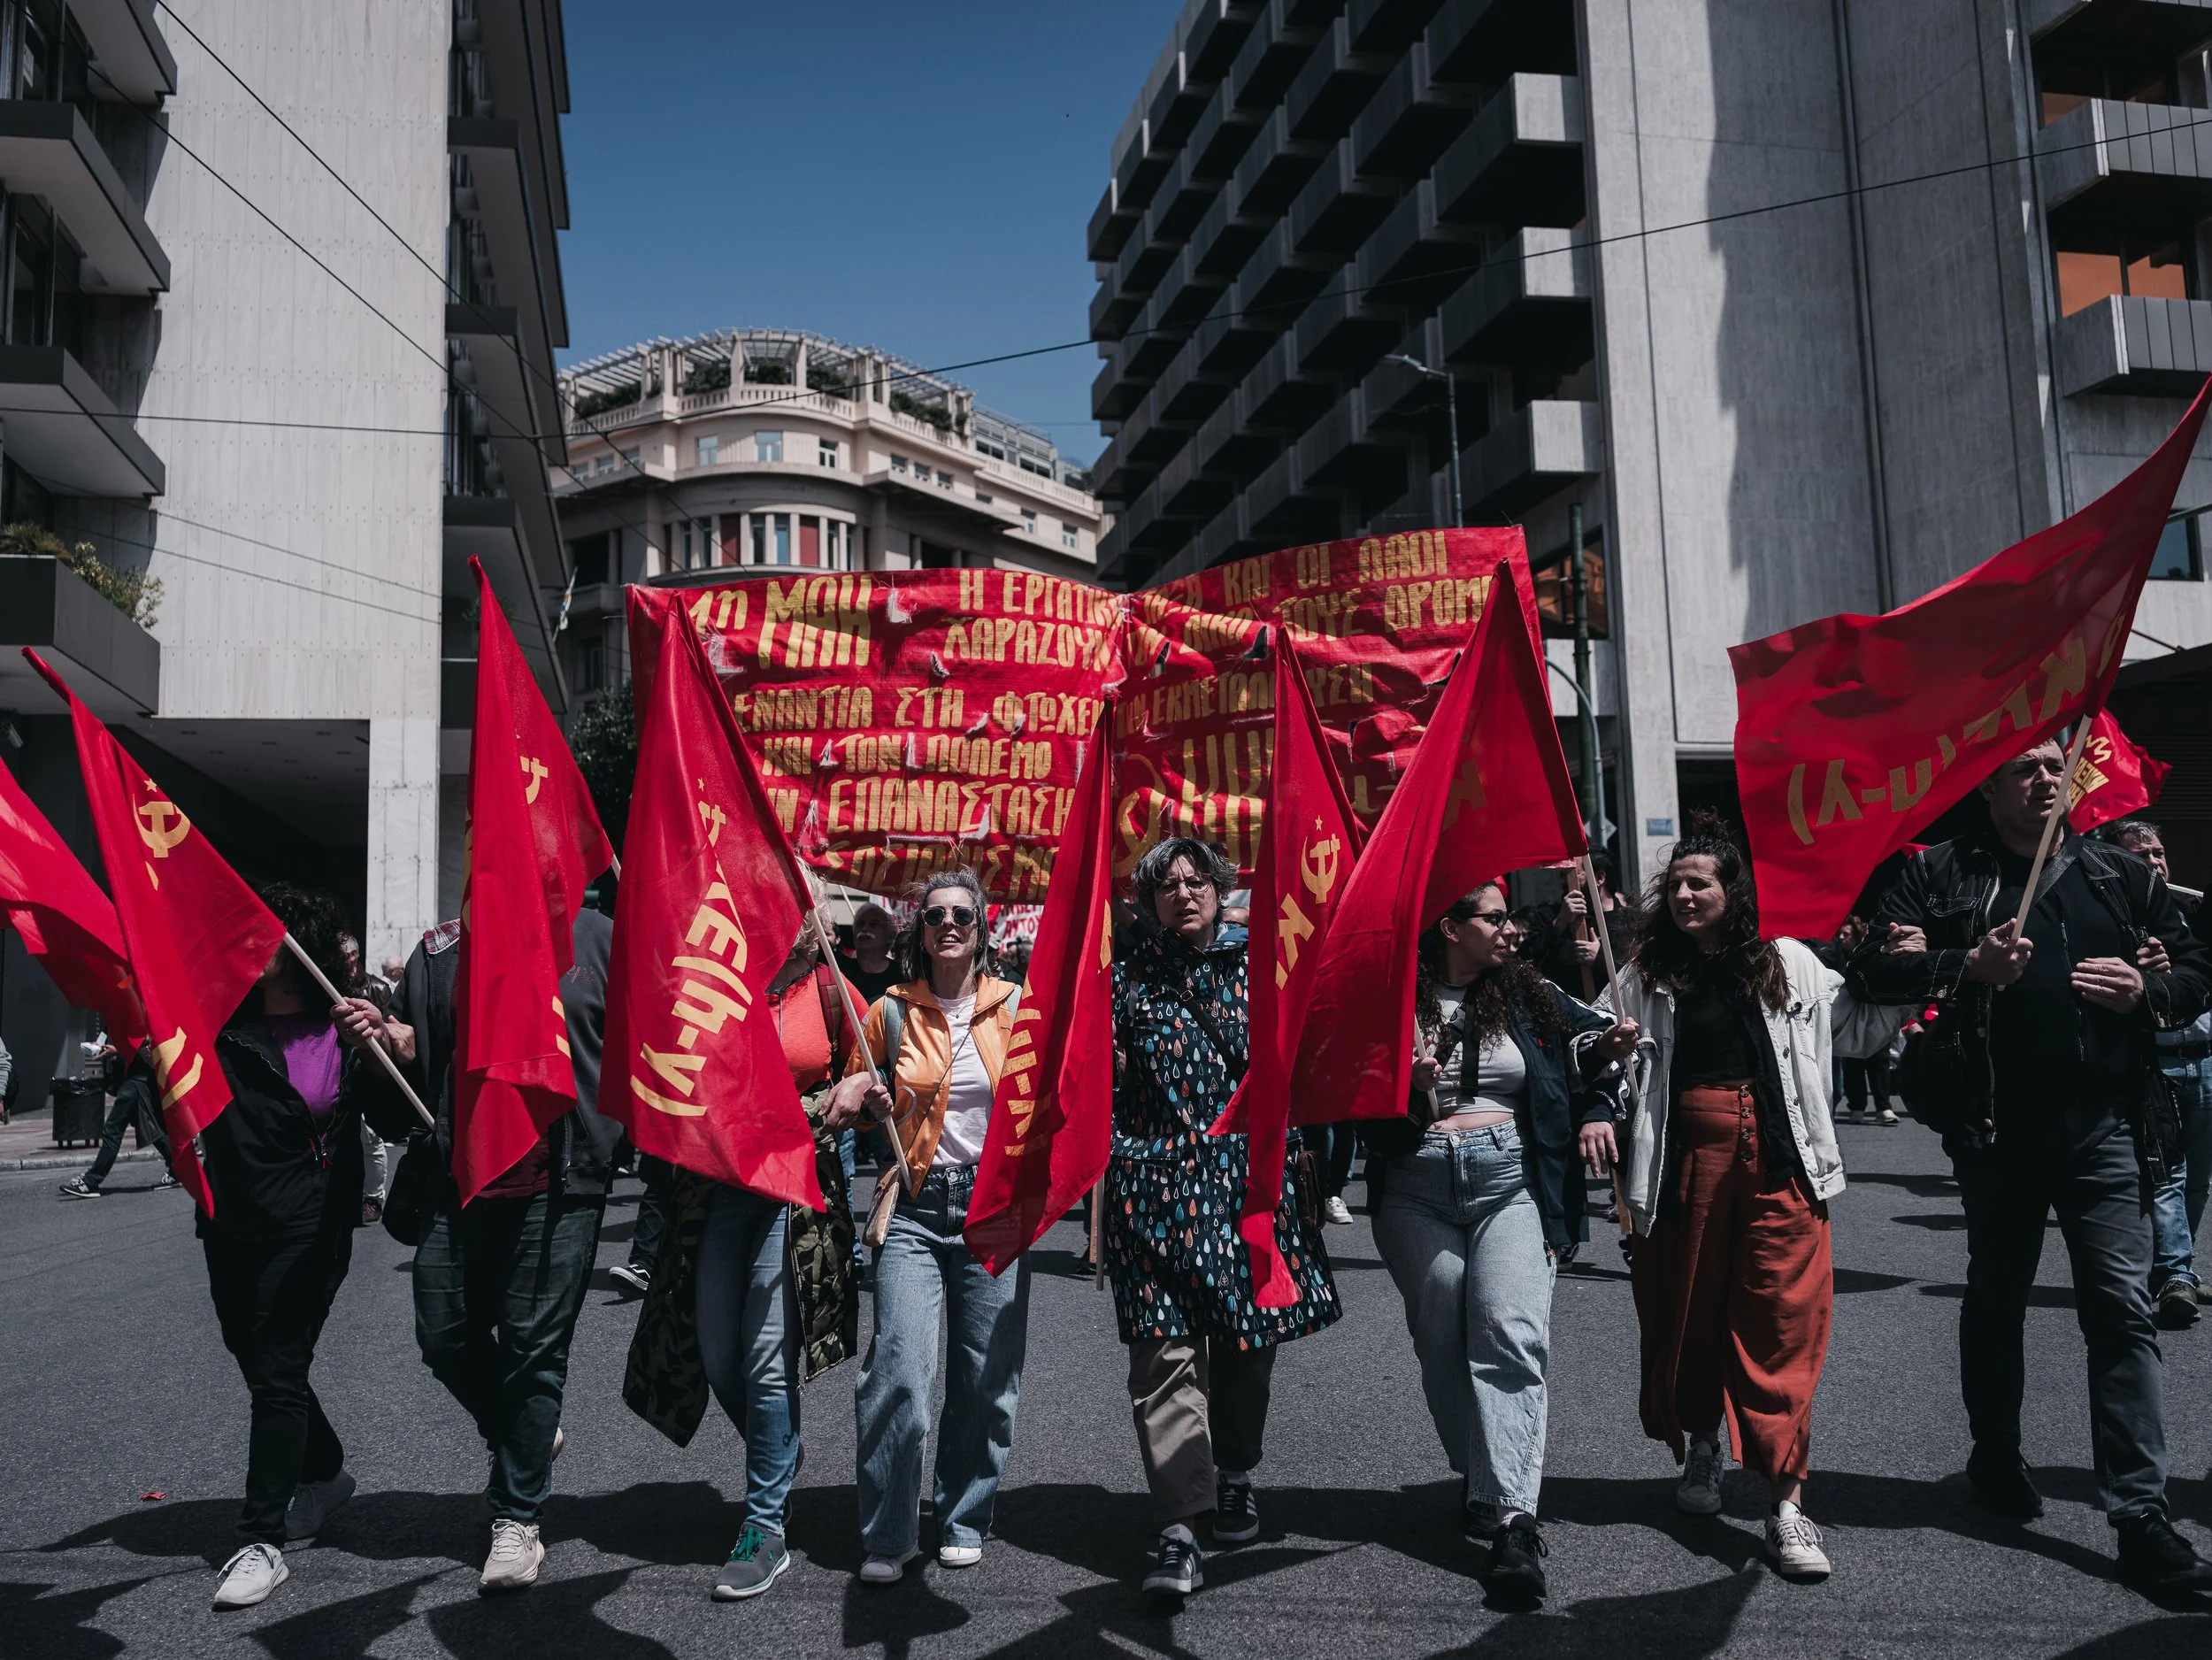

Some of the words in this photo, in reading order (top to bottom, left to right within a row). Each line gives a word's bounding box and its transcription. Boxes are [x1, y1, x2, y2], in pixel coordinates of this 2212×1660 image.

[959, 570, 985, 611] Η
[1223, 557, 1271, 607] ΚΑΙ
[1296, 543, 1333, 591] ΟΙ
[1358, 530, 1448, 584] ΛΑΟΙ
[1272, 588, 1366, 642] ΤΟΥΣ
[733, 684, 873, 734] ΕΝΑΝΤΙΑ
[895, 687, 964, 729] ΣΤΗ
[762, 735, 813, 777] ΚΑΙ
[834, 733, 902, 775] ΤΟΝ
[926, 734, 1052, 780] ΠΟΛΕΜΟ
[826, 776, 1076, 837] ΕΠΑΝΑΣΤΑΣΗ
